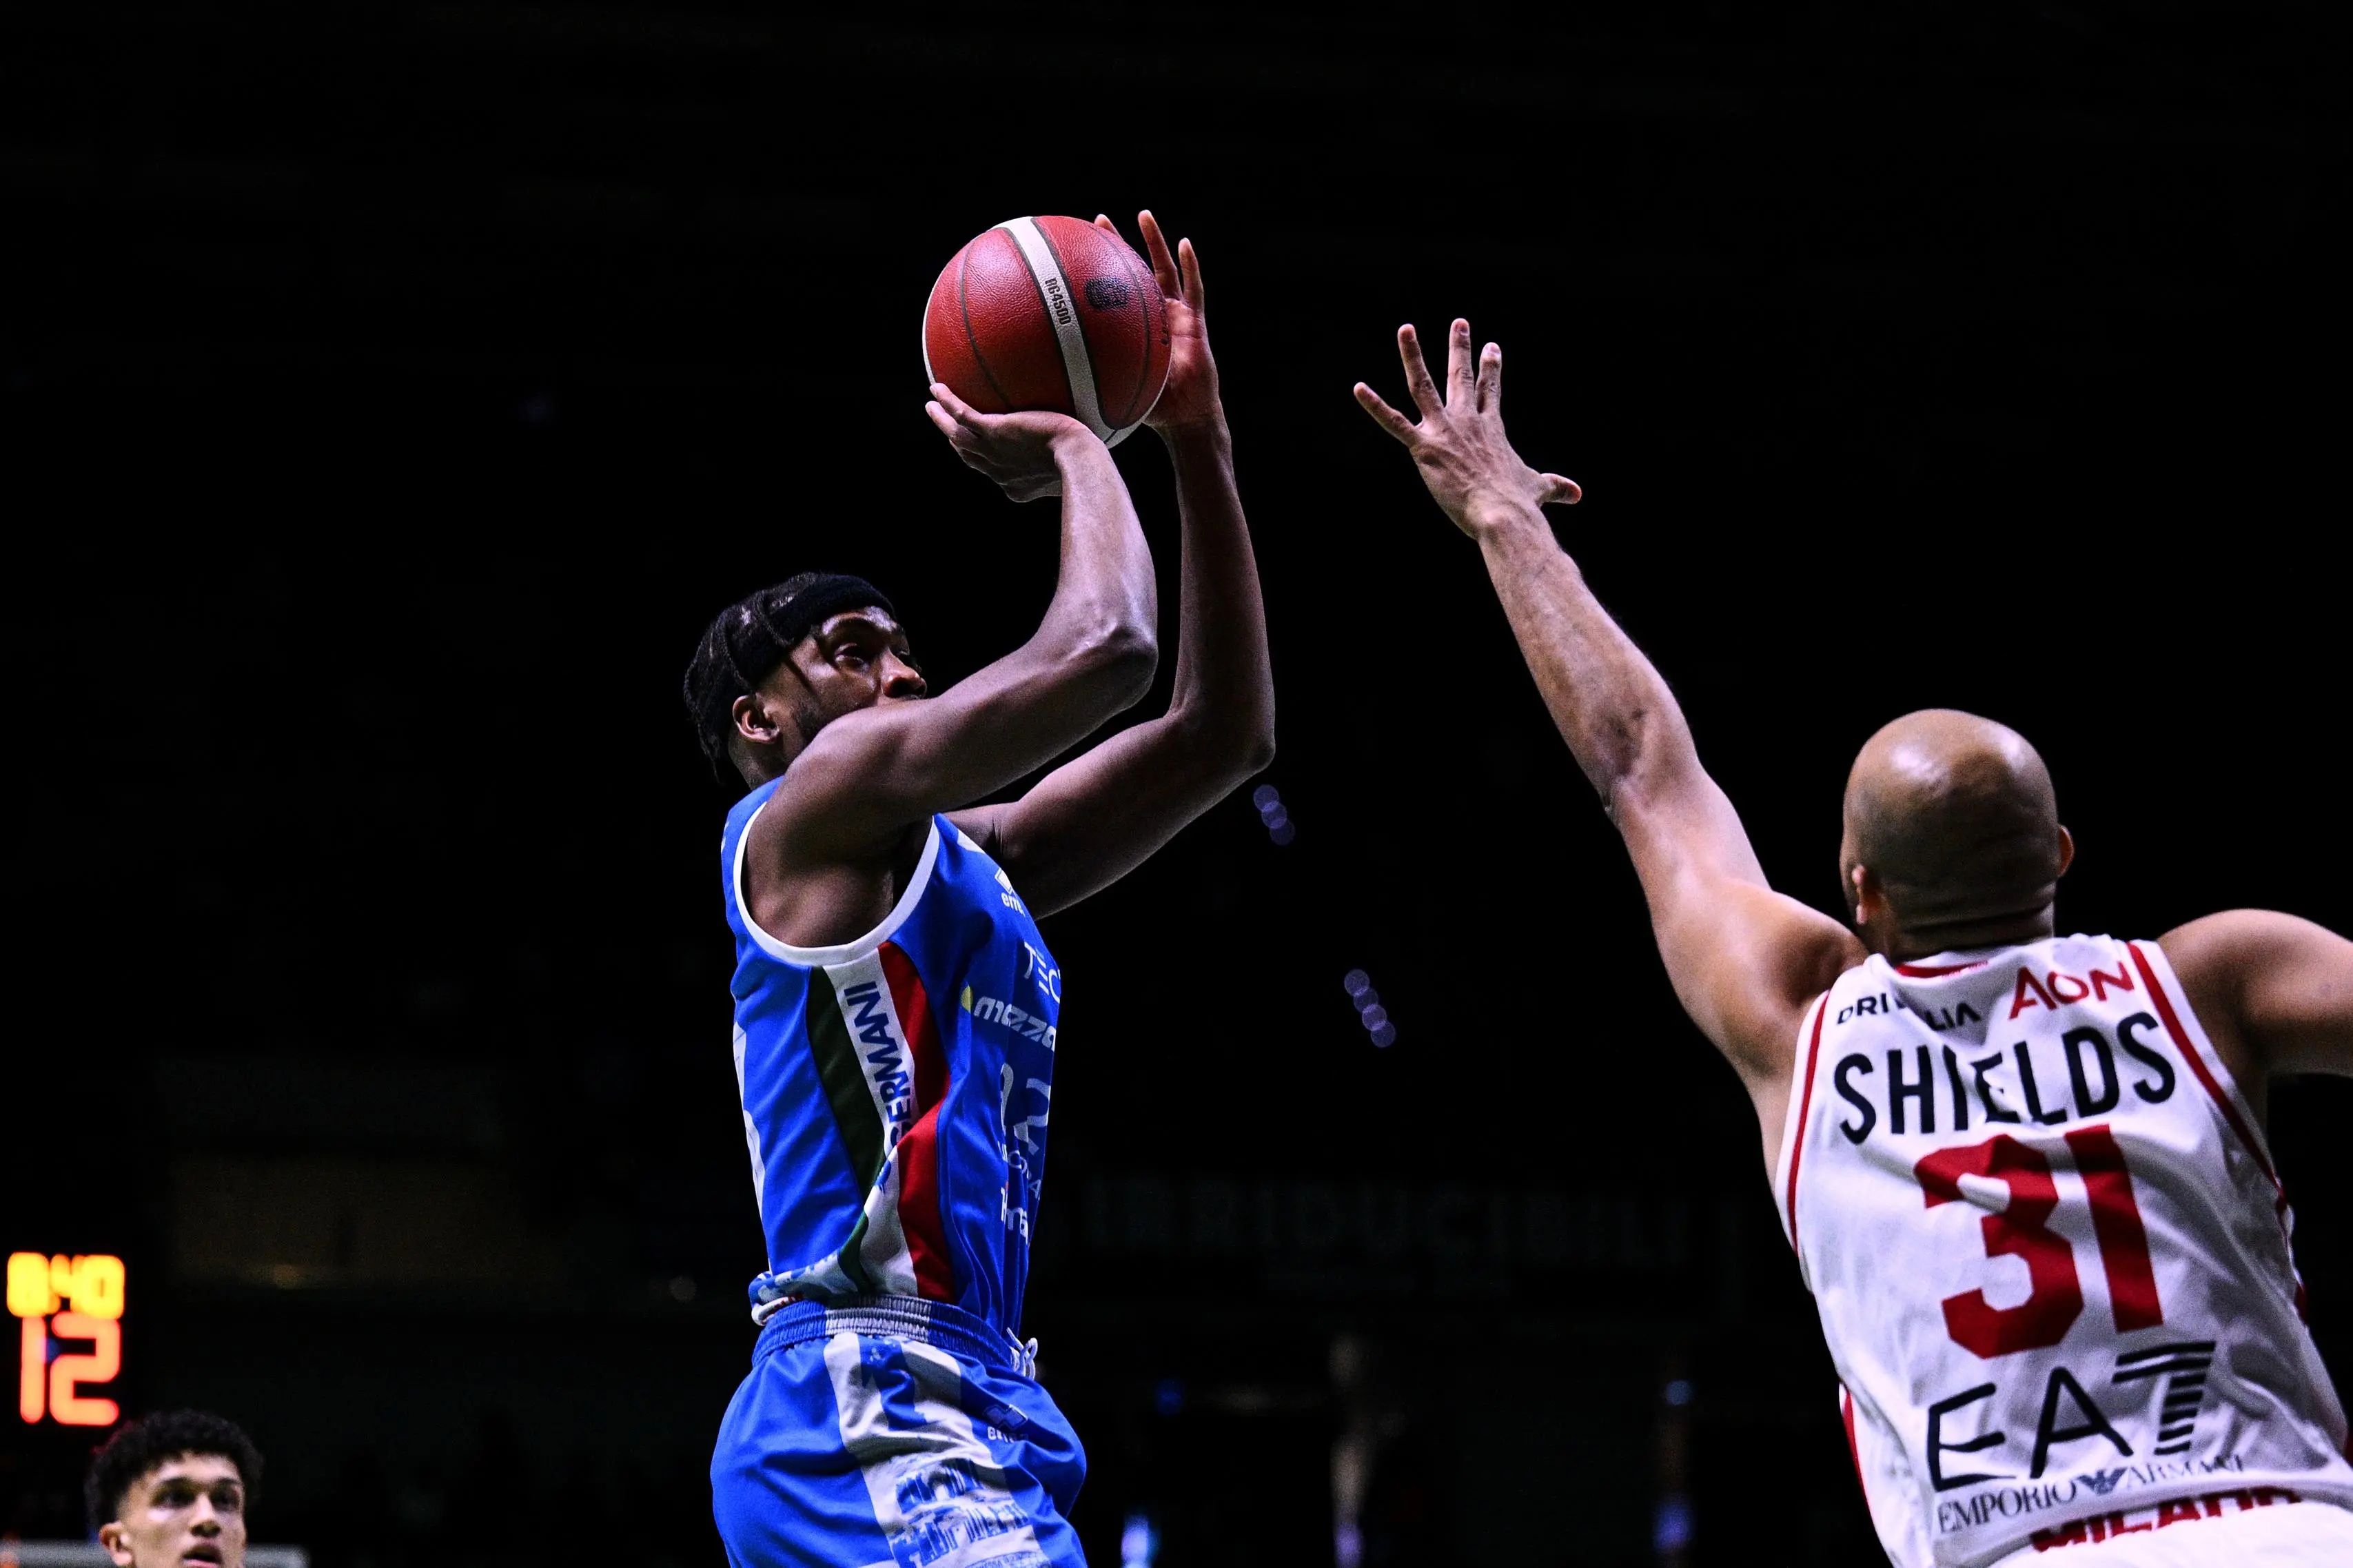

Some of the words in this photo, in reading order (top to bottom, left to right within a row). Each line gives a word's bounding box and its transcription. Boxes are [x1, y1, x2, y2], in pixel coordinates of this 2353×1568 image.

[1837, 992, 1982, 1031] DRILIA
[2008, 961, 2135, 1021] AON
[1833, 1012, 2176, 1145] SHIELDS
[1913, 1123, 2163, 1358] 31
[20, 1311, 121, 1426] 12
[1928, 1341, 2217, 1491] EA7
[1937, 1481, 2077, 1534] EMPORIO
